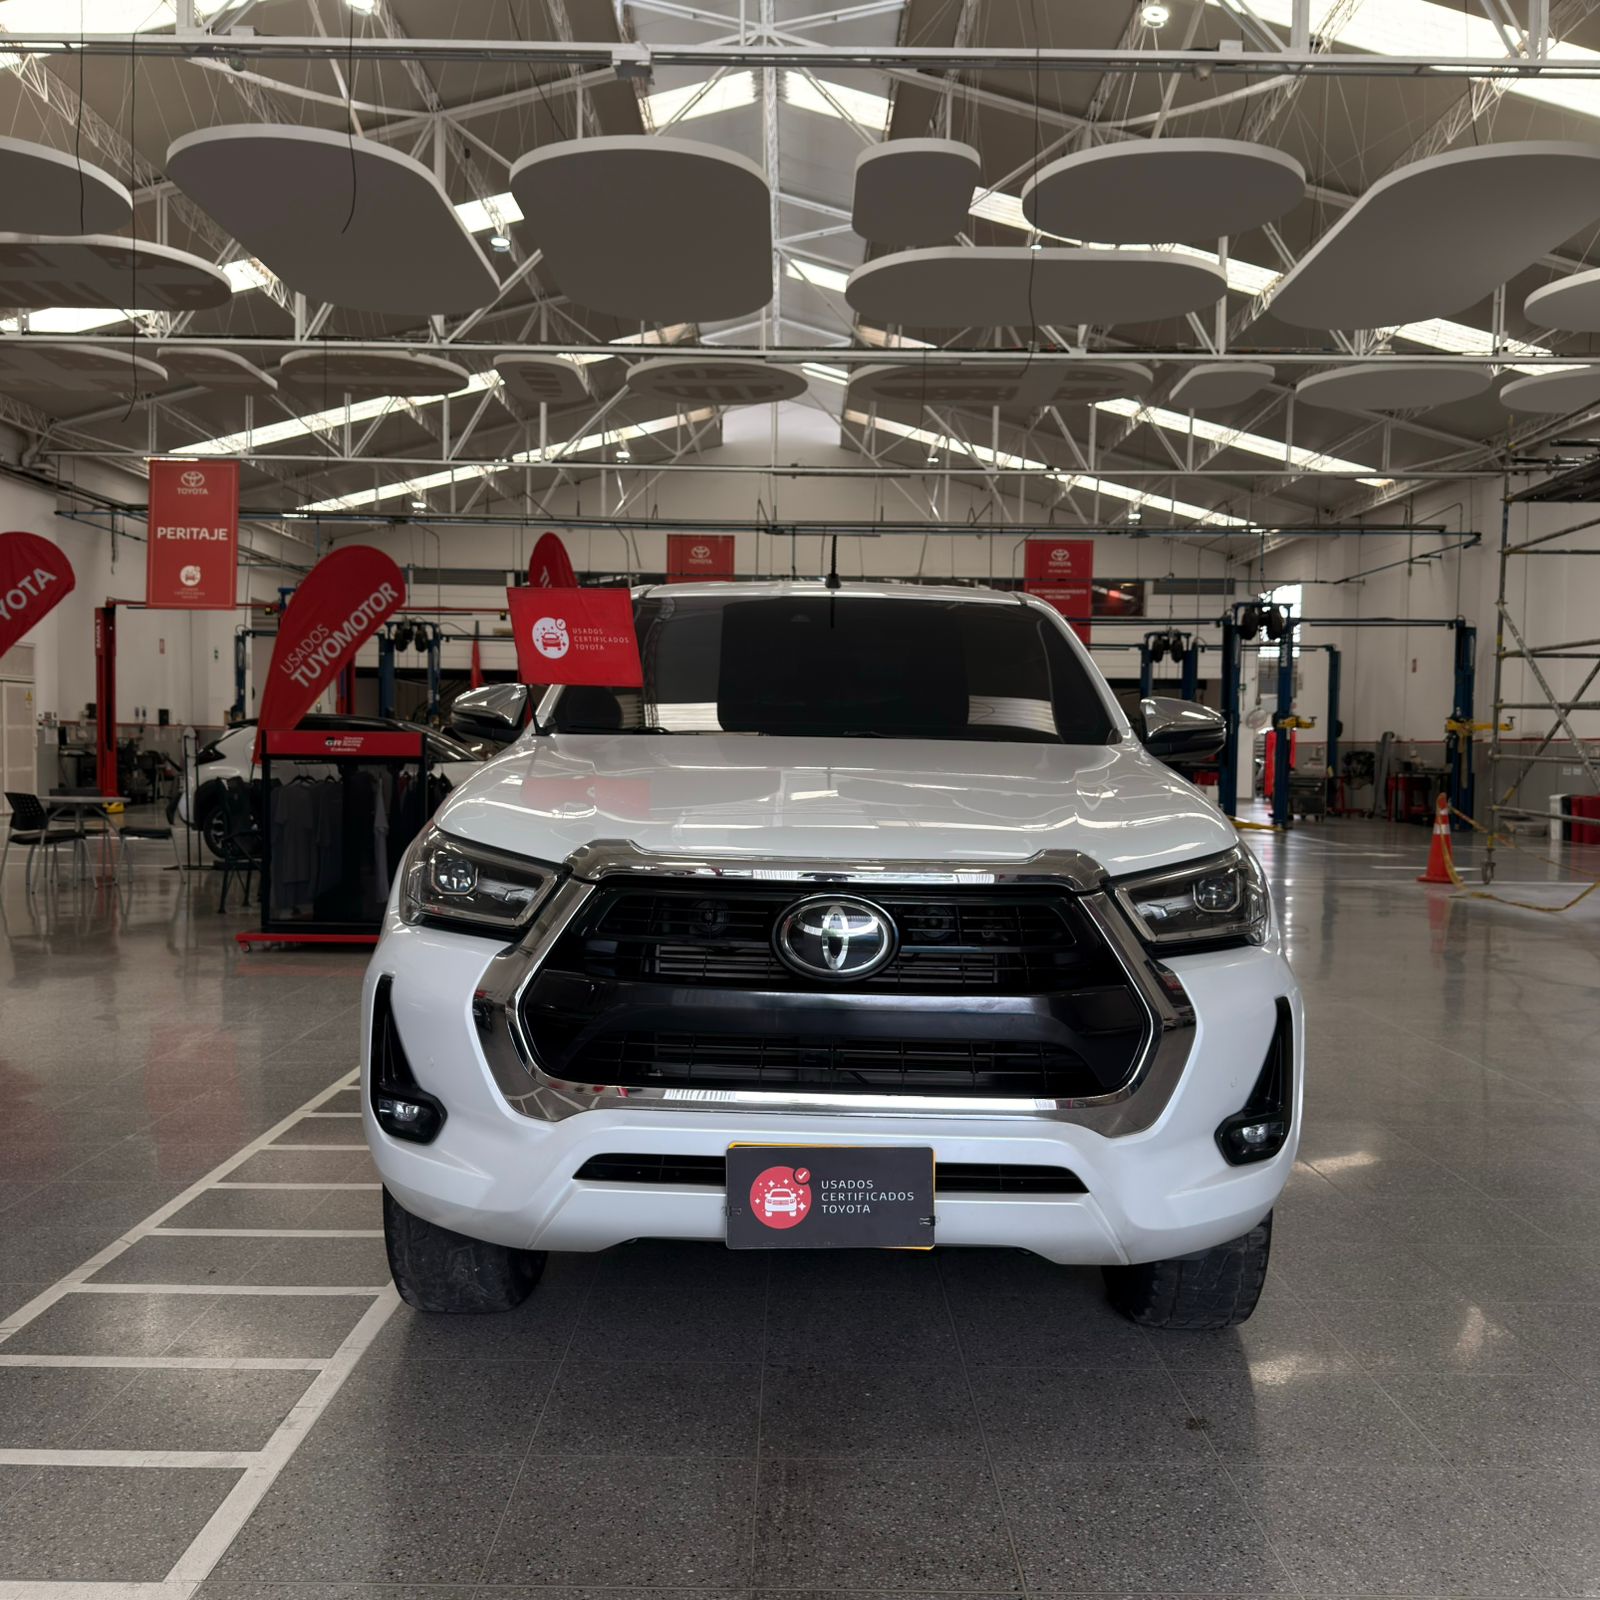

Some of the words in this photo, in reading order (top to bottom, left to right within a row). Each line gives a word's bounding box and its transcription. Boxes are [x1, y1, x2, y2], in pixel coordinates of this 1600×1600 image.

[177, 487, 208, 495] TOYOTA
[157, 526, 228, 541] PERITAJE
[290, 581, 399, 688] TUYOMOTOR
[572, 627, 604, 635] USADOS
[573, 636, 630, 644] CERTIFICADOS
[280, 623, 330, 674] USADOS
[575, 643, 605, 651] TOYOTA
[821, 1179, 874, 1190] USADOS
[821, 1191, 915, 1202] CERTIFICADOS
[821, 1204, 871, 1214] TOYOTA
